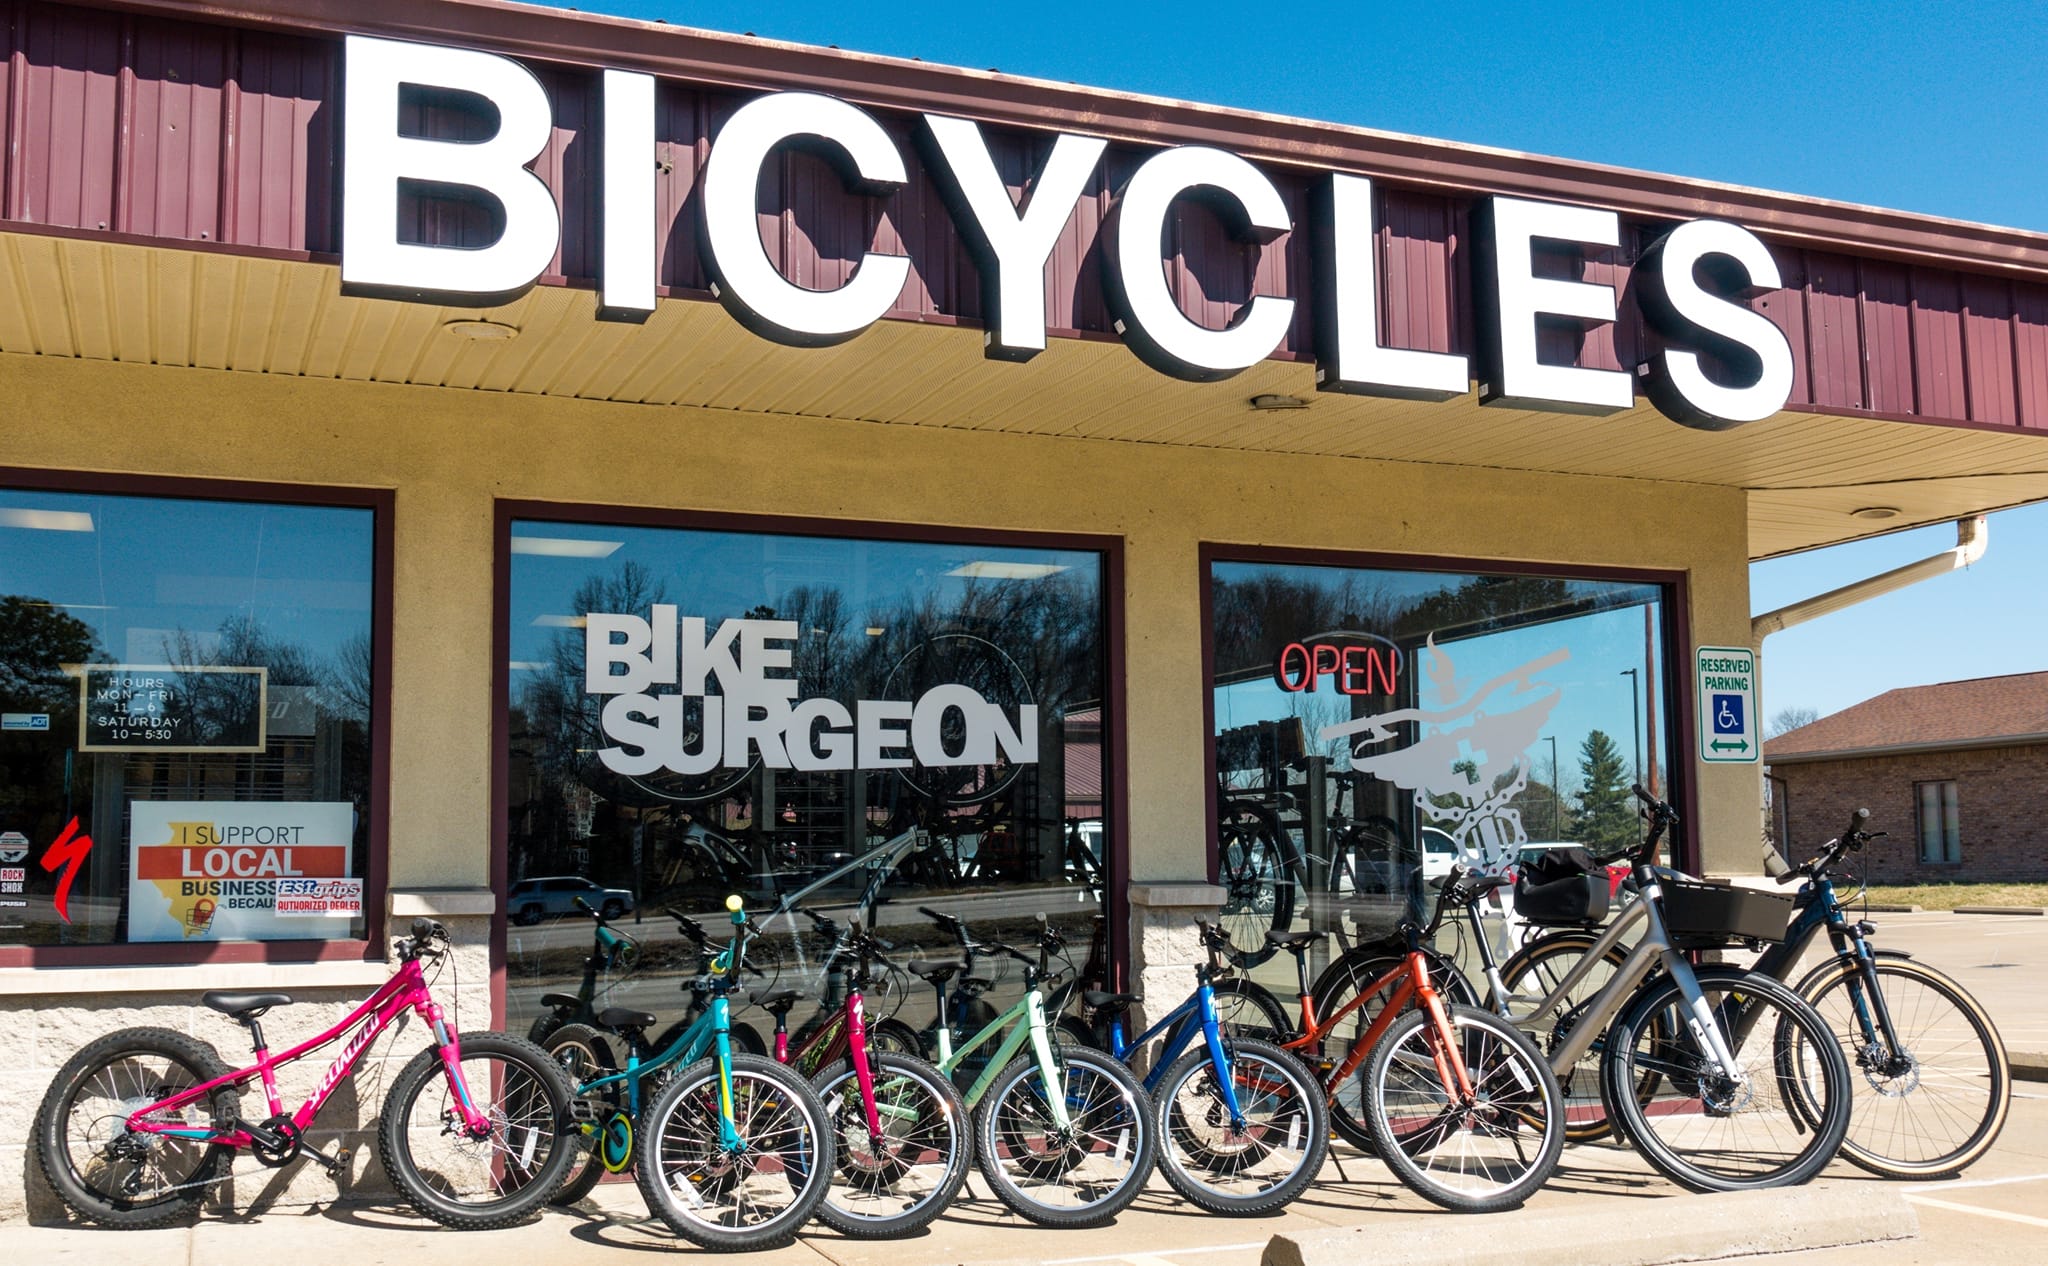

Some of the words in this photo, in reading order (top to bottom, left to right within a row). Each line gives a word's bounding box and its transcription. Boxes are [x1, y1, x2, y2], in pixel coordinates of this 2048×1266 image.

[342, 34, 1795, 425] BICYCLES
[585, 603, 799, 699] BIKE
[1280, 642, 1396, 695] OPEN
[1700, 658, 1751, 673] RESERVED
[109, 677, 165, 688] HOURS
[1704, 676, 1749, 691] PARKING
[98, 716, 182, 728] SATURDAY
[597, 683, 1039, 776] SURGEON
[182, 827, 187, 844] I
[195, 826, 304, 845] SUPPORT
[182, 847, 304, 877] LOCAL
[2, 869, 25, 880] ROCK
[1, 882, 23, 893] SHOX
[228, 897, 276, 909] BECAU
[277, 900, 328, 911] AUTHORIZED
[329, 900, 360, 911] DEALER
[308, 1011, 381, 1111] SPECIALIZED
